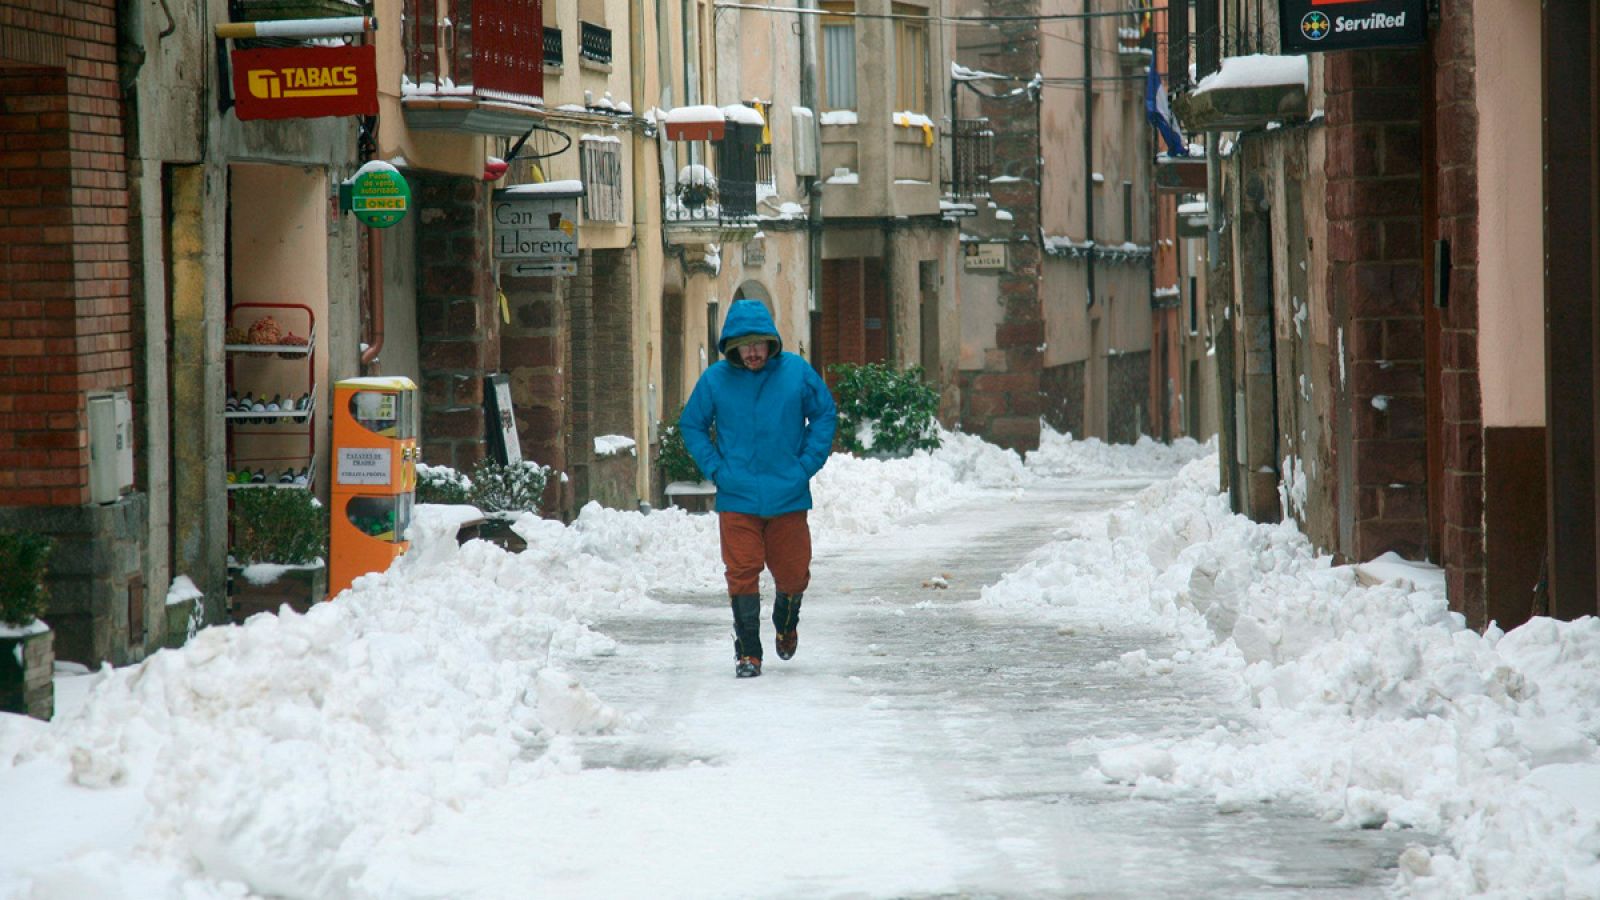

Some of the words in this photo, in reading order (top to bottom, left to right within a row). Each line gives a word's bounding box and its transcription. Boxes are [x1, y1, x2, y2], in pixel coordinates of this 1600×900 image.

[1335, 11, 1406, 32] ServiRed
[281, 66, 357, 88] TABACS
[367, 199, 401, 209] ONCE
[495, 203, 533, 225] Can
[501, 230, 573, 255] Llorenç
